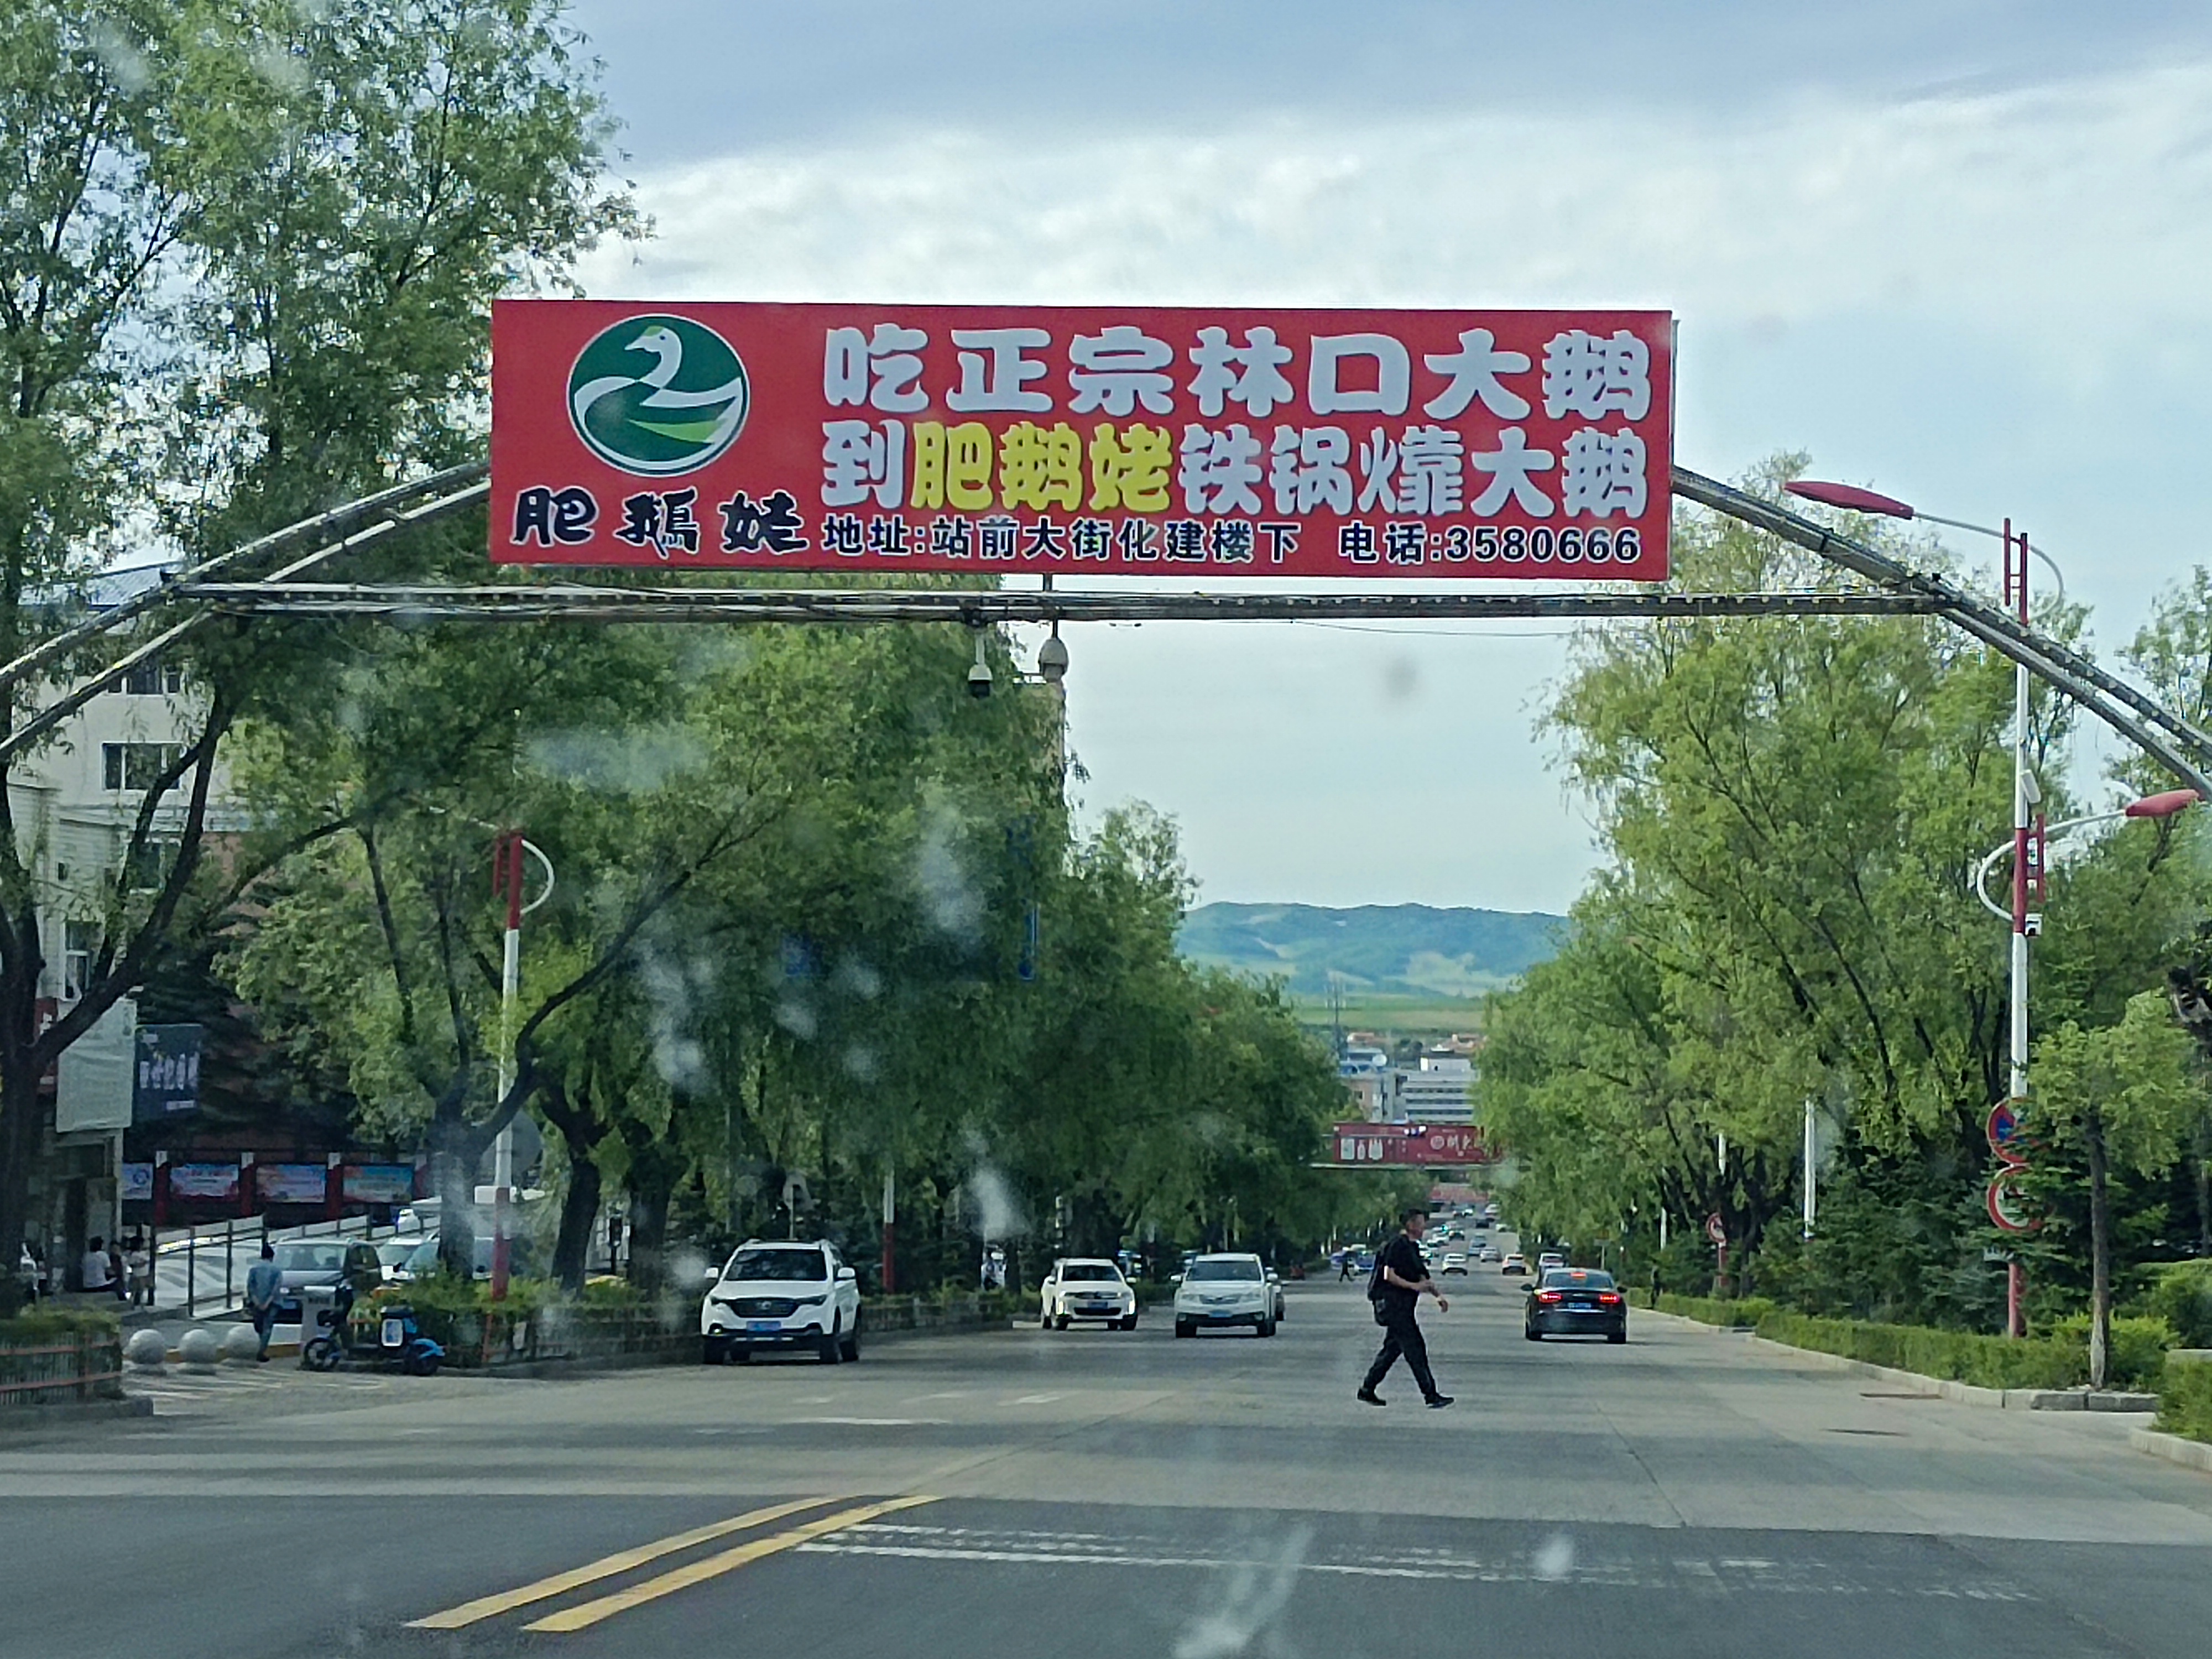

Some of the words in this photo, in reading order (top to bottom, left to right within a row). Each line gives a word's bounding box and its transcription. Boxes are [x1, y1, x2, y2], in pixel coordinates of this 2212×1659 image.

[823, 323, 1651, 421] 吃正宗林口大鹅
[1338, 520, 1641, 564] 电话:3580666
